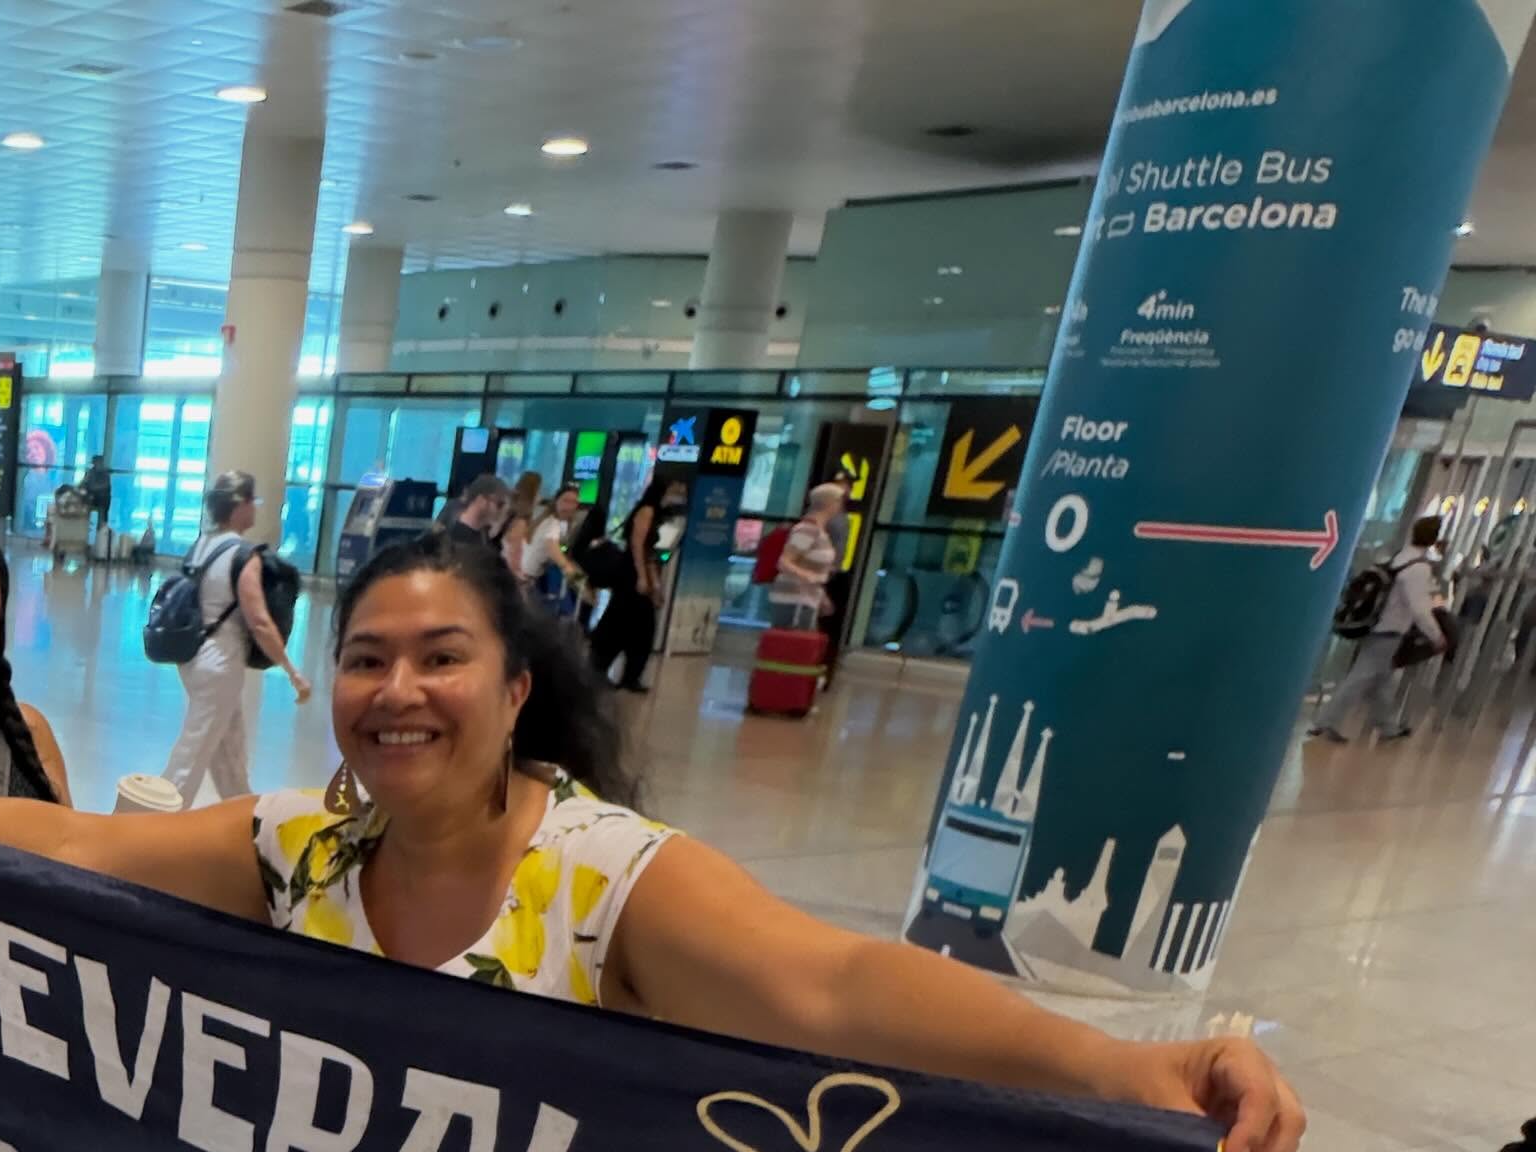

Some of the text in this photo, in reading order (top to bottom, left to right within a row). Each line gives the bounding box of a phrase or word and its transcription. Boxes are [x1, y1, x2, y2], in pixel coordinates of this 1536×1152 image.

[1126, 153, 1243, 194] Shuttle
[1256, 151, 1333, 184] Bus
[1143, 196, 1337, 233] Barcelona
[1060, 415, 1128, 441] Floor
[710, 445, 743, 465] ATM
